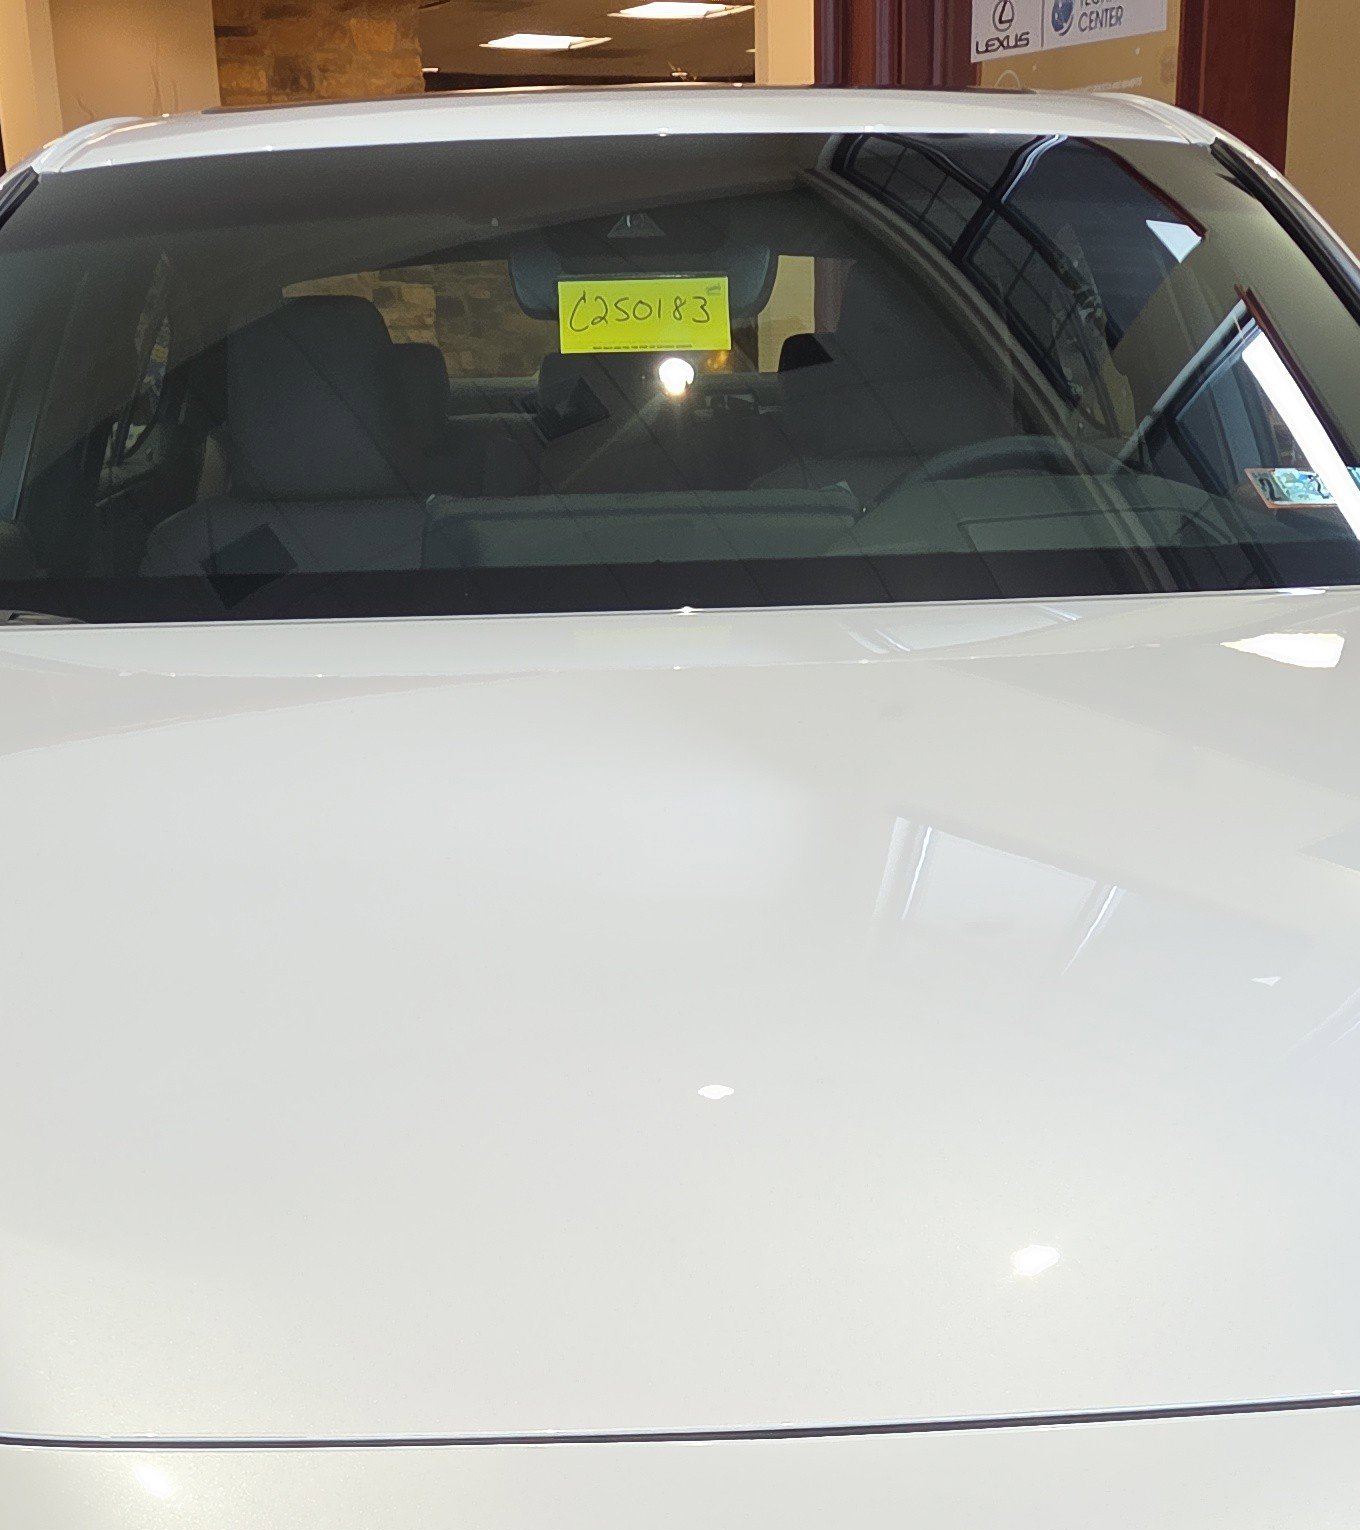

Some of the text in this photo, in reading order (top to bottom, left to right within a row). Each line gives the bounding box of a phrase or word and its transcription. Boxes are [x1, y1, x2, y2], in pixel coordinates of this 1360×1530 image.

[1077, 6, 1124, 33] CENTER
[974, 31, 1030, 55] LEXUS
[569, 290, 711, 333] C250183
